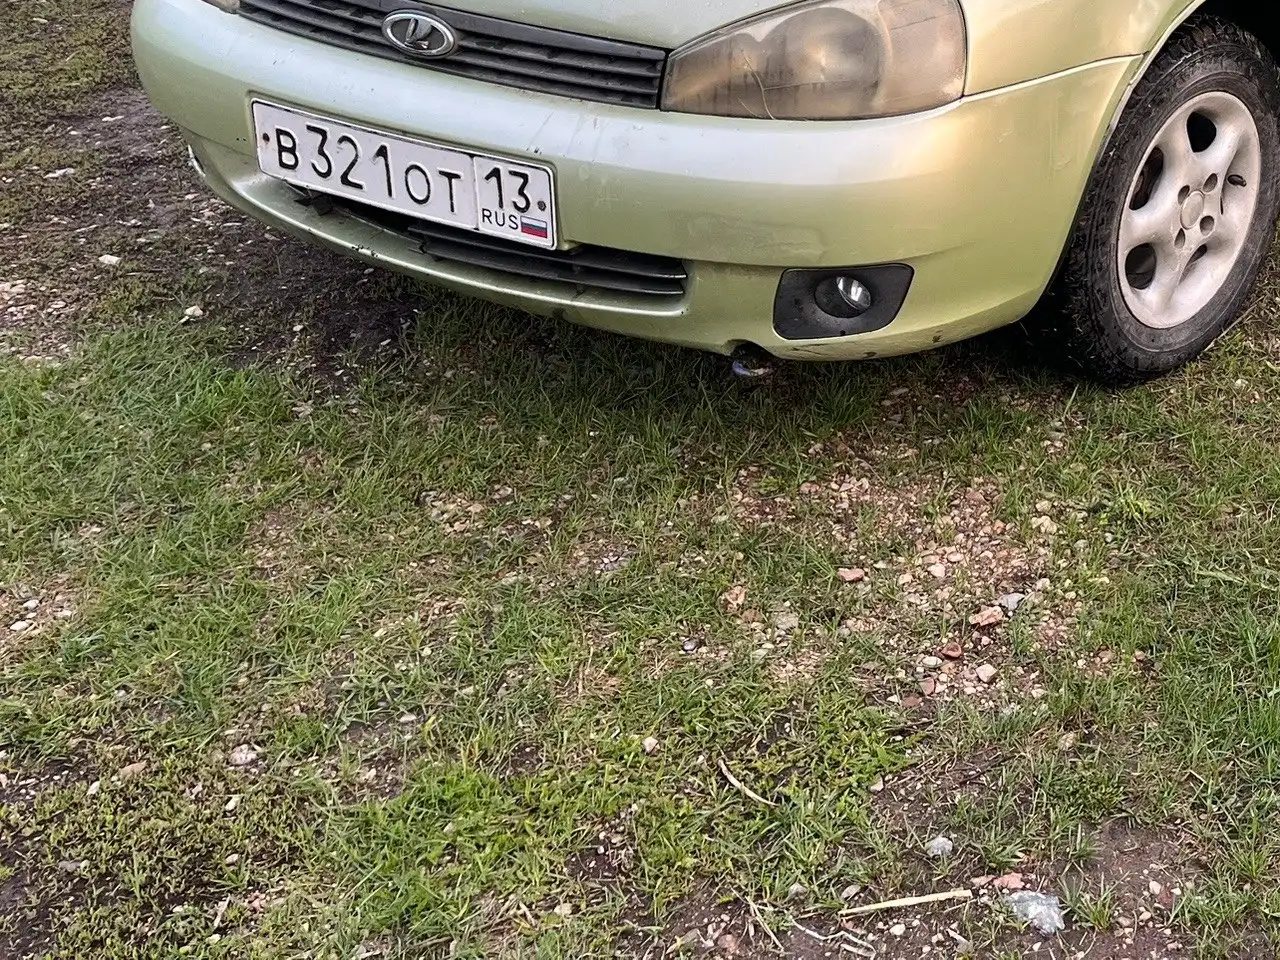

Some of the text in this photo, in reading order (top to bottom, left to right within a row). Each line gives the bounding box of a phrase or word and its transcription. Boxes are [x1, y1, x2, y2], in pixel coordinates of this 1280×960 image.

[275, 124, 532, 214] В321ОТ 13
[481, 207, 519, 231] RUS
